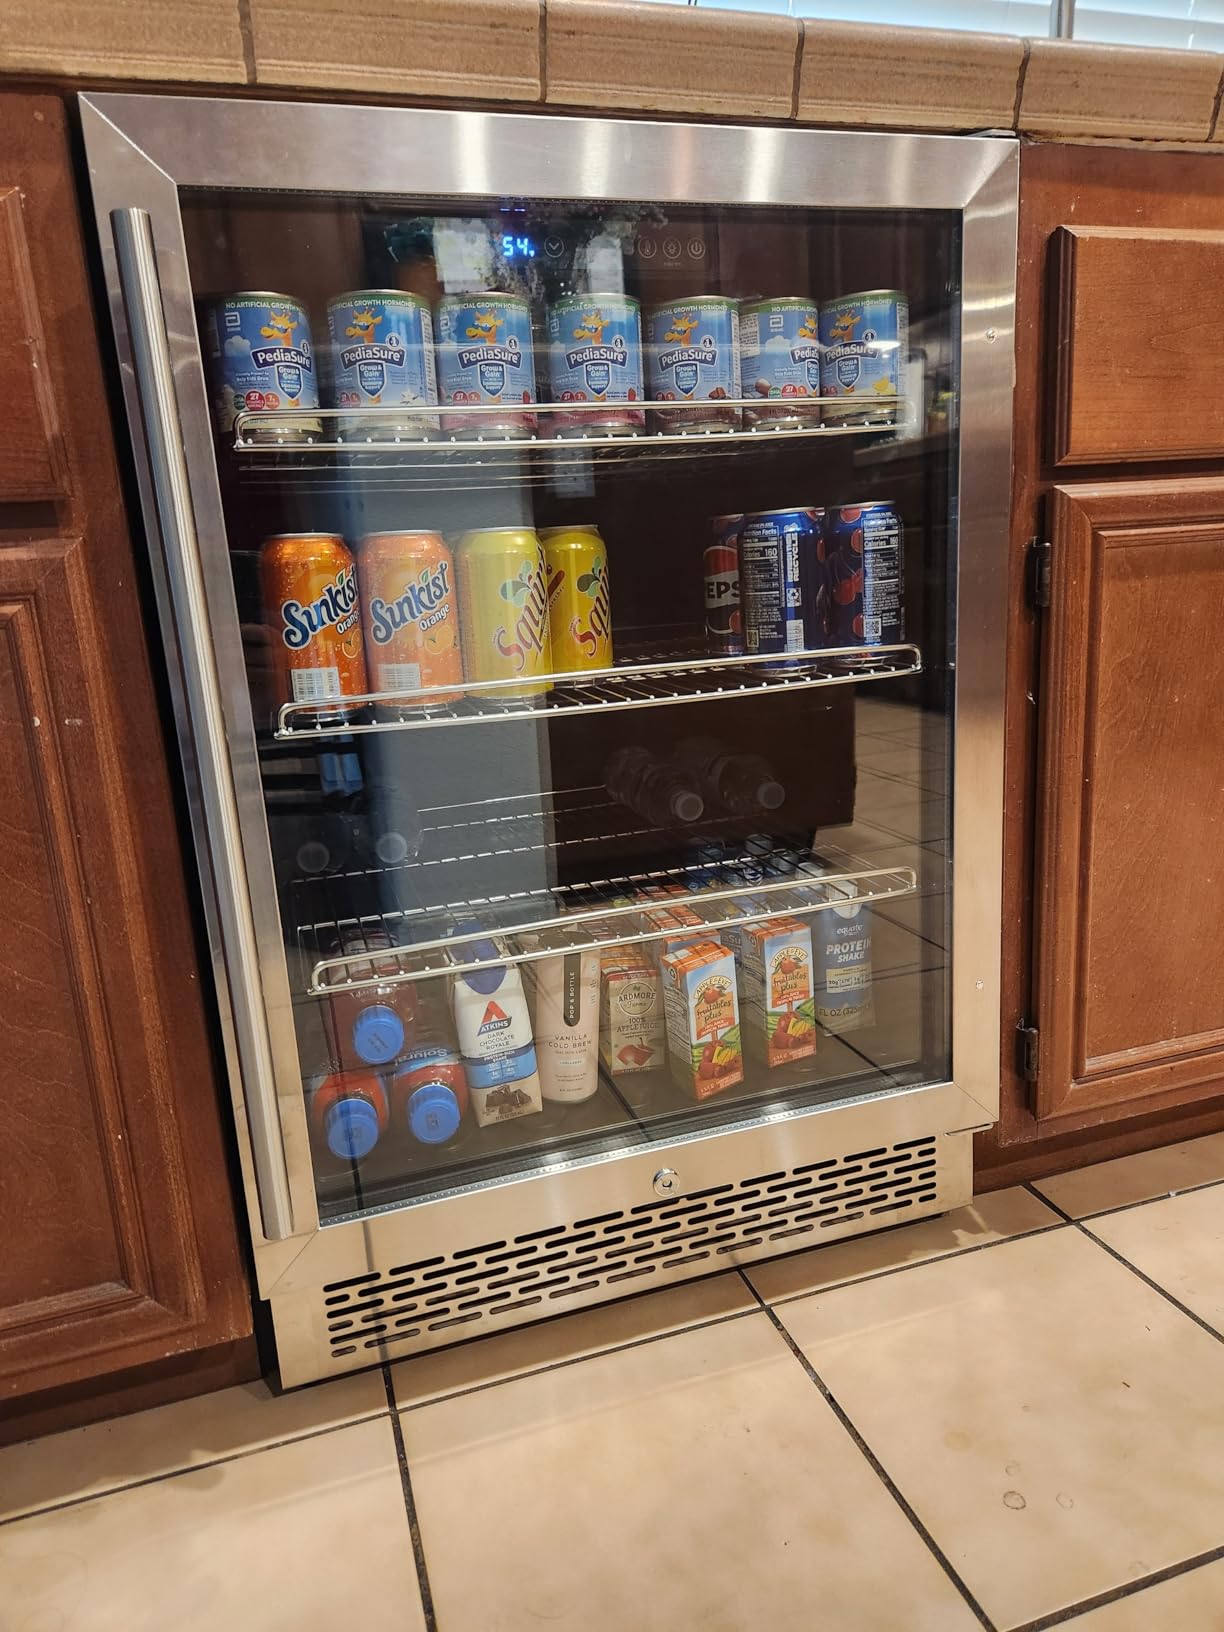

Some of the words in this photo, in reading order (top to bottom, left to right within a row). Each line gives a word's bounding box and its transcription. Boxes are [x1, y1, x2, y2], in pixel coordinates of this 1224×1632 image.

[236, 301, 270, 309] ARTIFICIAL
[270, 302, 296, 310] GROWTH
[382, 299, 416, 308] HORMONES
[673, 305, 698, 314] GROWTH
[837, 302, 861, 310] GROWTH
[861, 298, 893, 307] HORMONES
[256, 348, 311, 367] PediaSure
[343, 346, 401, 364] PediaSure
[462, 347, 519, 364] PediaSure
[569, 347, 624, 364] PediaSure
[661, 348, 713, 367] PediaSure
[826, 343, 874, 361] PediaSure
[864, 540, 887, 548] Calories
[791, 531, 800, 582] RECYCLE
[706, 580, 741, 599] EPS
[281, 562, 359, 650] Sunkist
[370, 559, 451, 646] Sunkist
[418, 603, 451, 632] Orange
[825, 937, 872, 955] PROTEIN
[837, 950, 865, 963] SHAKE
[773, 971, 807, 988] fruitables
[781, 981, 798, 995] plus
[618, 991, 656, 1002] ARDMORE
[696, 998, 732, 1020] fruitables
[830, 1009, 841, 1017] OZ
[704, 1010, 723, 1024] plus
[480, 1020, 509, 1033] ATKINS
[616, 1024, 639, 1033] APPLE
[480, 1034, 515, 1047] CHOCOLATE
[487, 1031, 505, 1039] DARK
[554, 1033, 588, 1041] VANILLA
[486, 1041, 510, 1050] ROYALE
[548, 1041, 569, 1049] COLD
[572, 1040, 592, 1049] BREW
